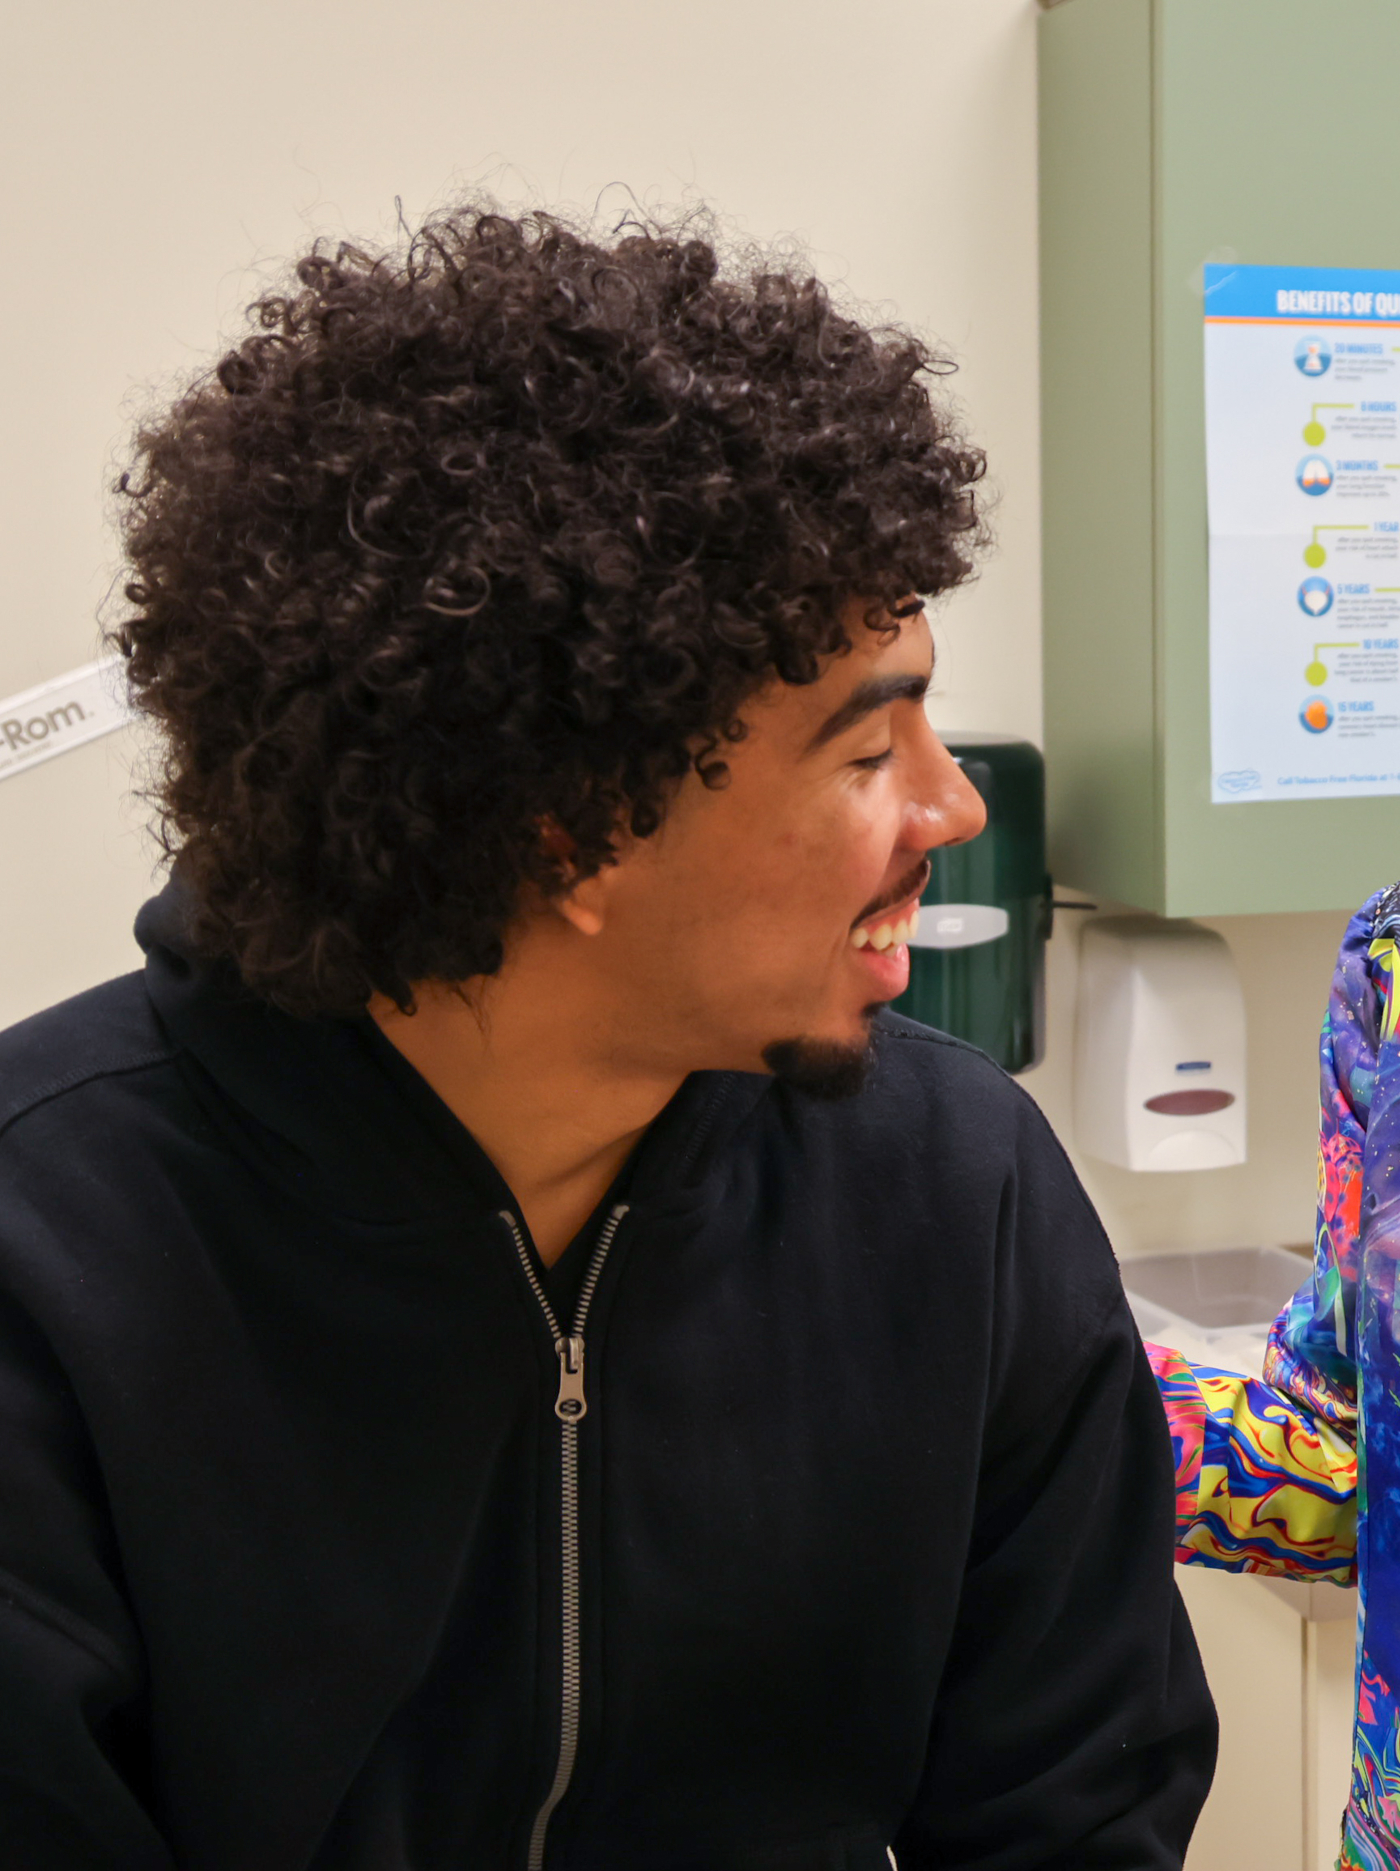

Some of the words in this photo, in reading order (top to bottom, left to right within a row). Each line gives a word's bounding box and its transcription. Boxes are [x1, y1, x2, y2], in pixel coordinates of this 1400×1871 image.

[1277, 289, 1351, 316] BENEFITS
[1352, 291, 1374, 316] OF
[1367, 401, 1397, 412] HOURS
[1342, 460, 1379, 471] MONTHS
[1379, 522, 1400, 532] YEAR
[1344, 583, 1371, 594] YEARS
[1373, 638, 1400, 649] YEARS
[1337, 702, 1347, 712] 15
[1348, 701, 1375, 712] YEARS
[1277, 776, 1293, 785] Call
[1294, 775, 1328, 784] Tobacco
[1328, 774, 1348, 783] Free
[1348, 773, 1378, 782] Florida
